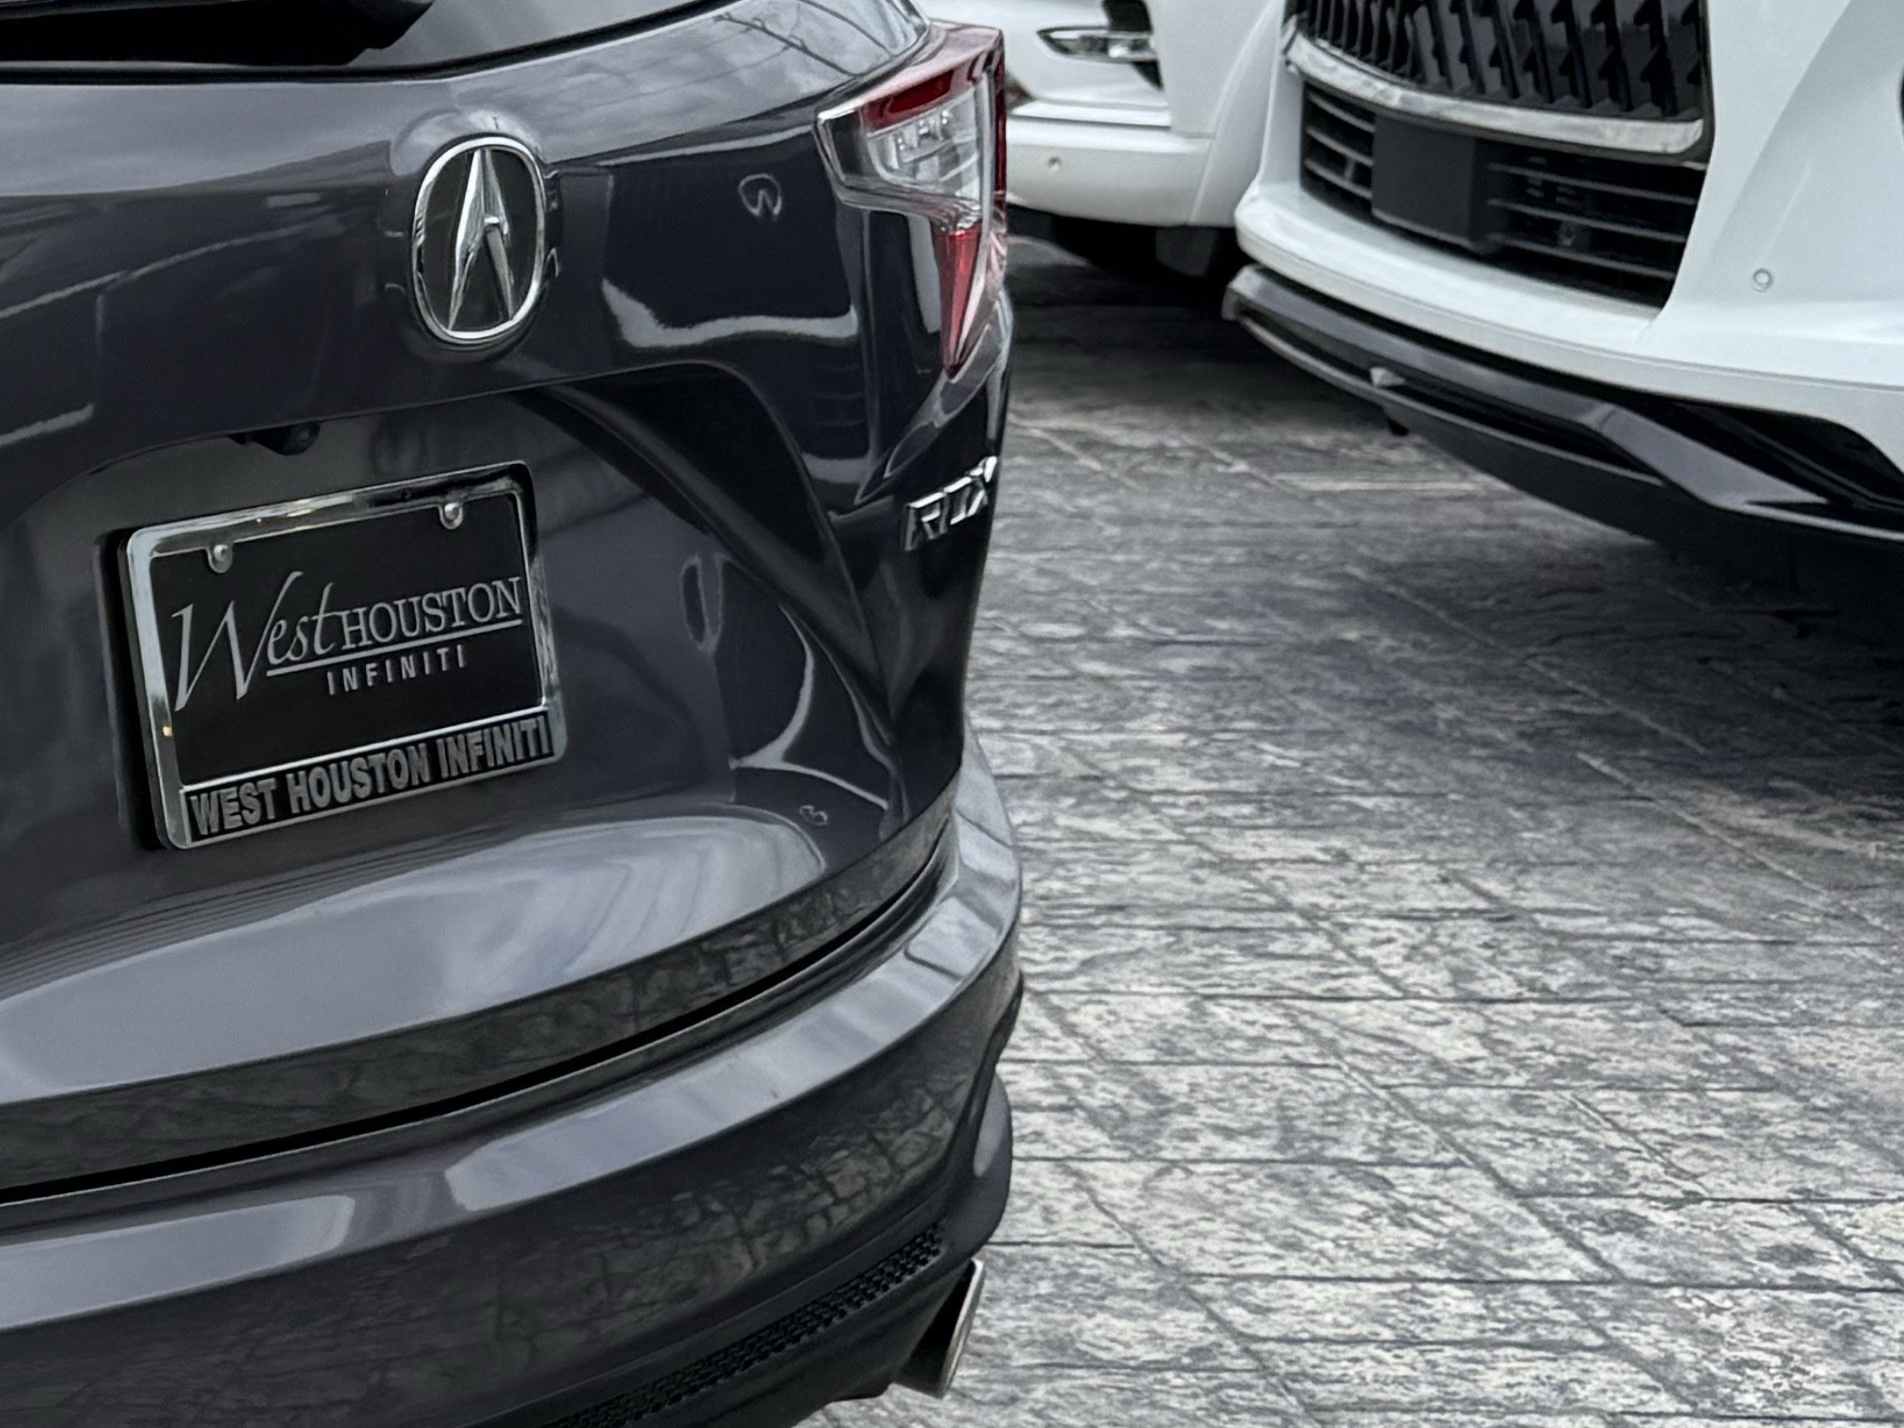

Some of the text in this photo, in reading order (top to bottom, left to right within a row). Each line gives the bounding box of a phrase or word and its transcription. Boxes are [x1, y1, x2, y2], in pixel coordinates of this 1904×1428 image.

[171, 571, 521, 712] West HOUSTON
[327, 644, 466, 695] INFINITI
[191, 715, 551, 836] WEST HOUSTON INFINITI
